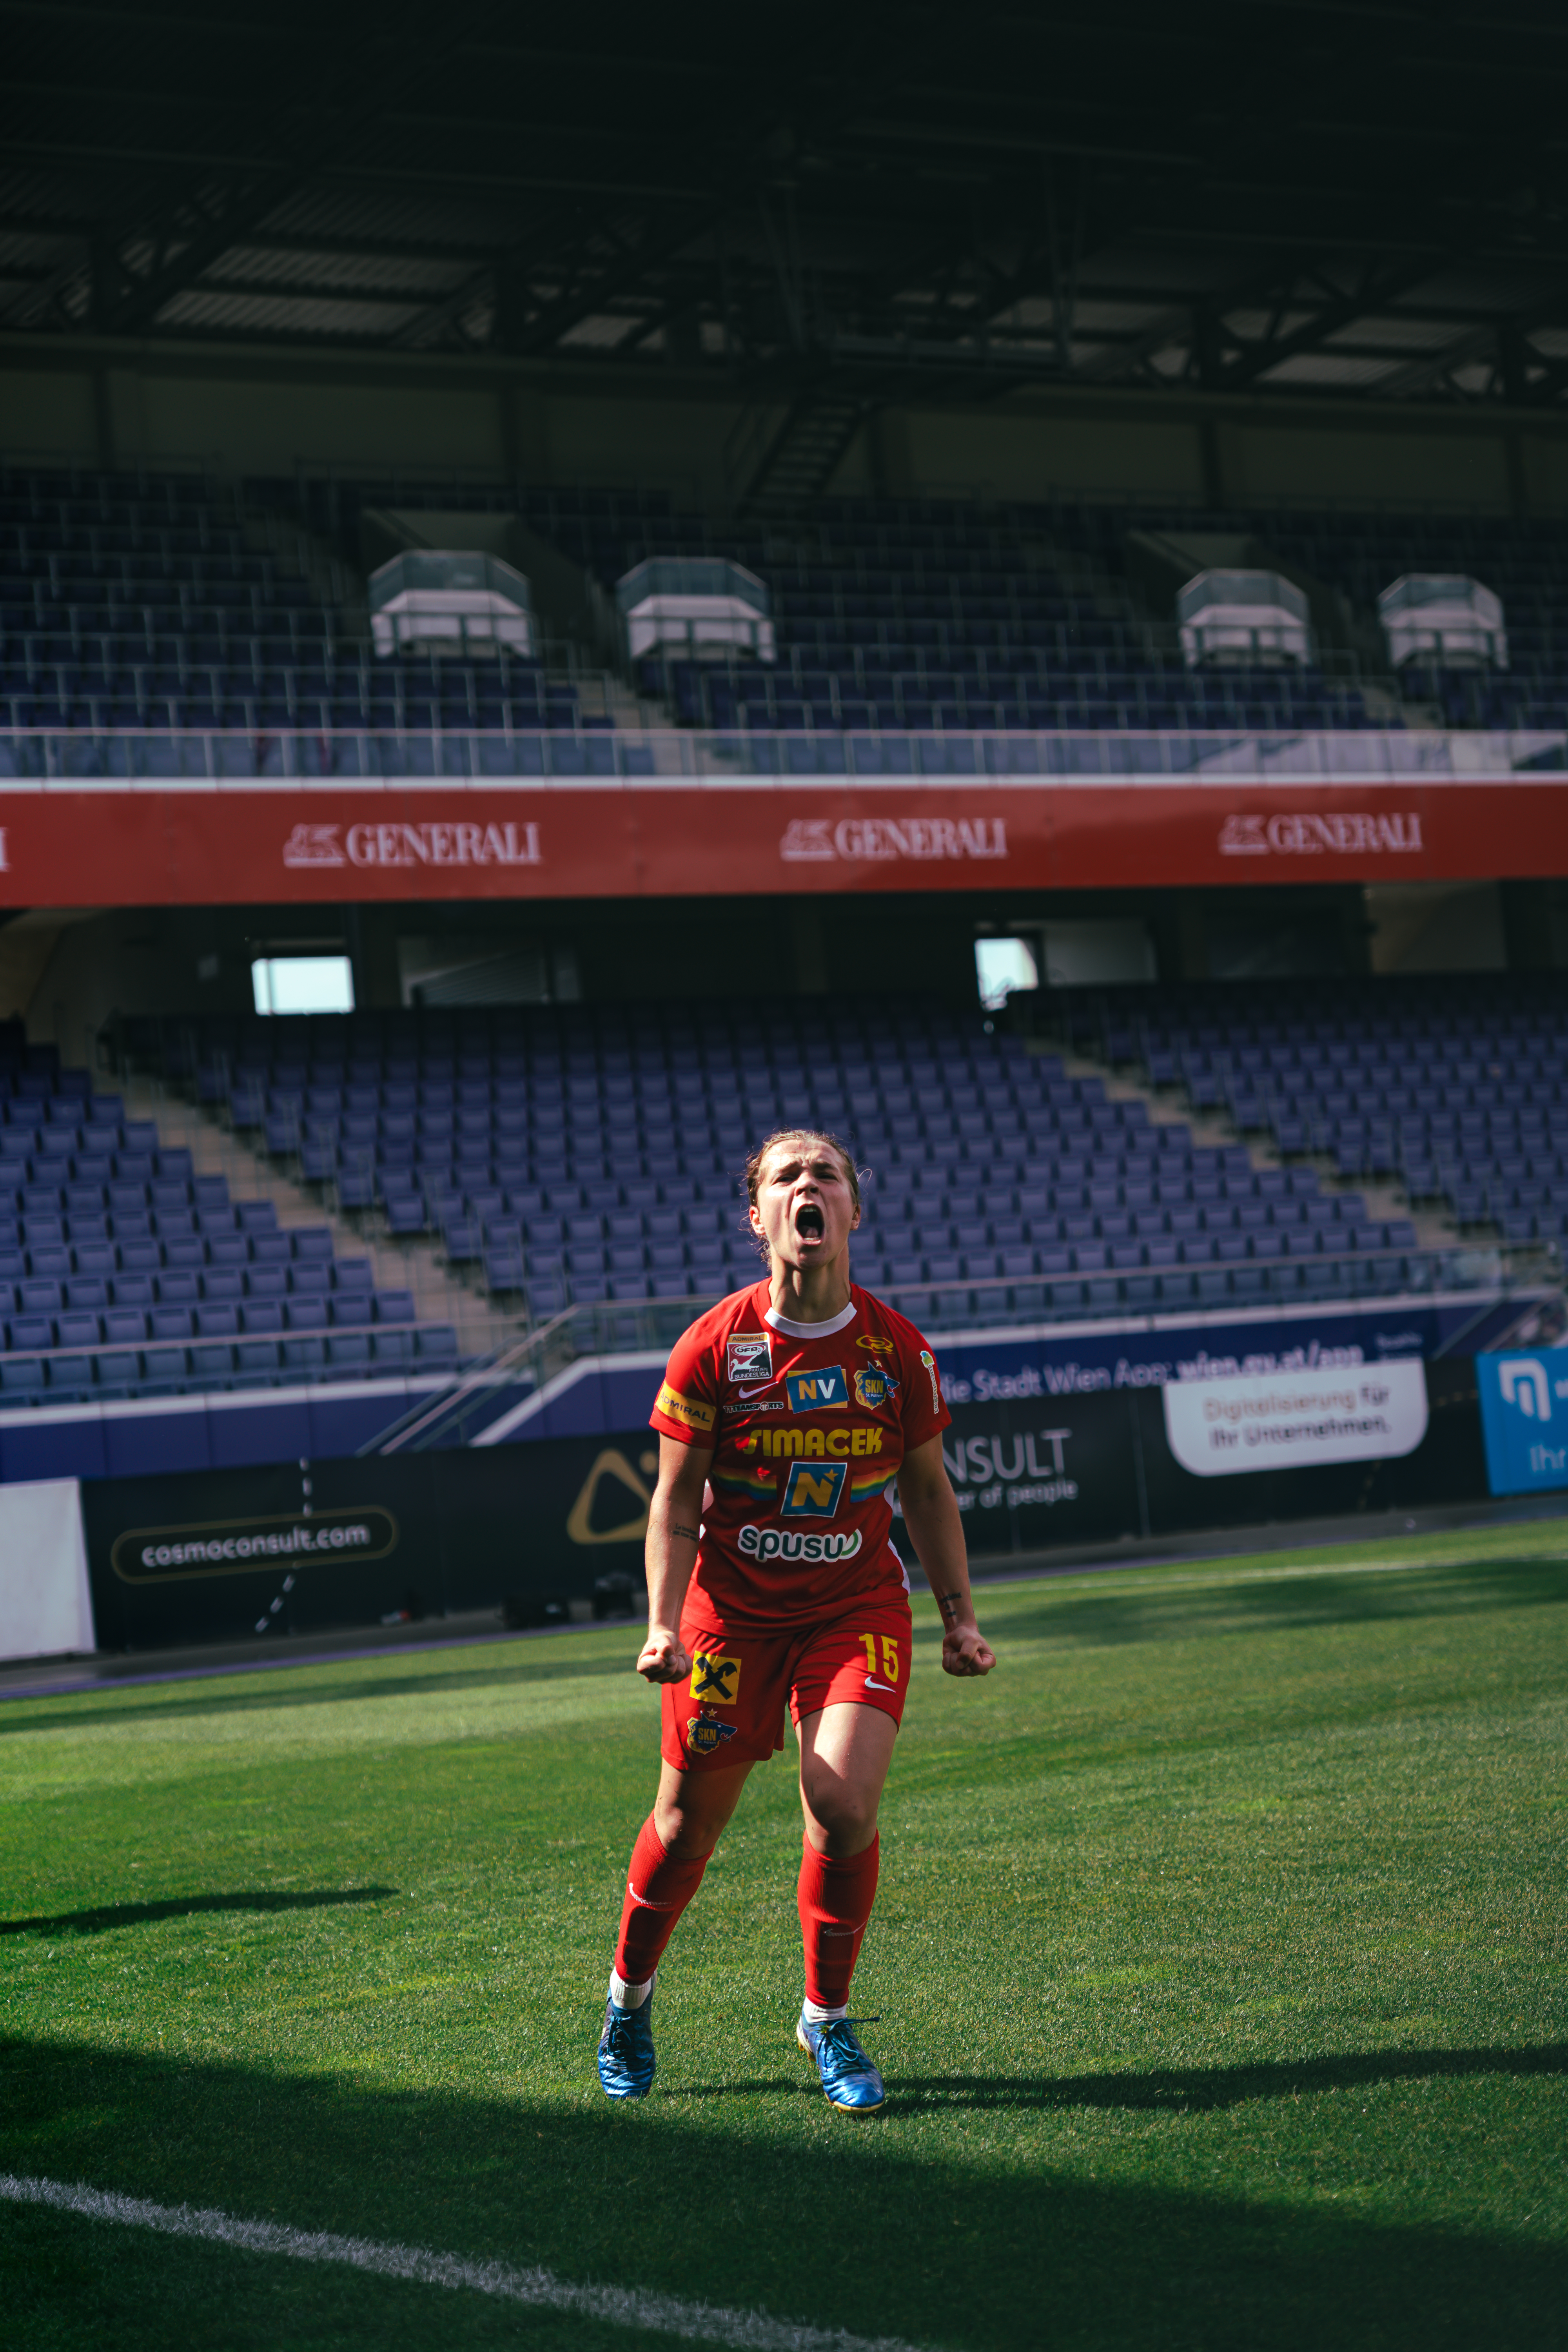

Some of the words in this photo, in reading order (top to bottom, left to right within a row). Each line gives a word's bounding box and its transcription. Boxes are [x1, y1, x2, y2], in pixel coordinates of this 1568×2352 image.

[345, 822, 541, 868] GENERALI
[834, 817, 1009, 861] GENERALI
[1266, 812, 1424, 855] GENERALI
[799, 1379, 835, 1400] NV
[865, 1379, 883, 1393] SKN
[928, 1365, 939, 1414] westbahn
[973, 1364, 1044, 1402] Stadt
[1043, 1362, 1112, 1395] Wien
[661, 1392, 710, 1423] ADMIRAL
[744, 1428, 883, 1457] SIMACEK
[942, 1427, 1073, 1484] NSULT
[979, 1482, 1004, 1508] of
[1006, 1476, 1079, 1510] people
[141, 1524, 372, 1568] cosmoconsult.com
[740, 1528, 844, 1561] spusu
[858, 1633, 899, 1683] 15
[698, 1728, 716, 1741] SKN
